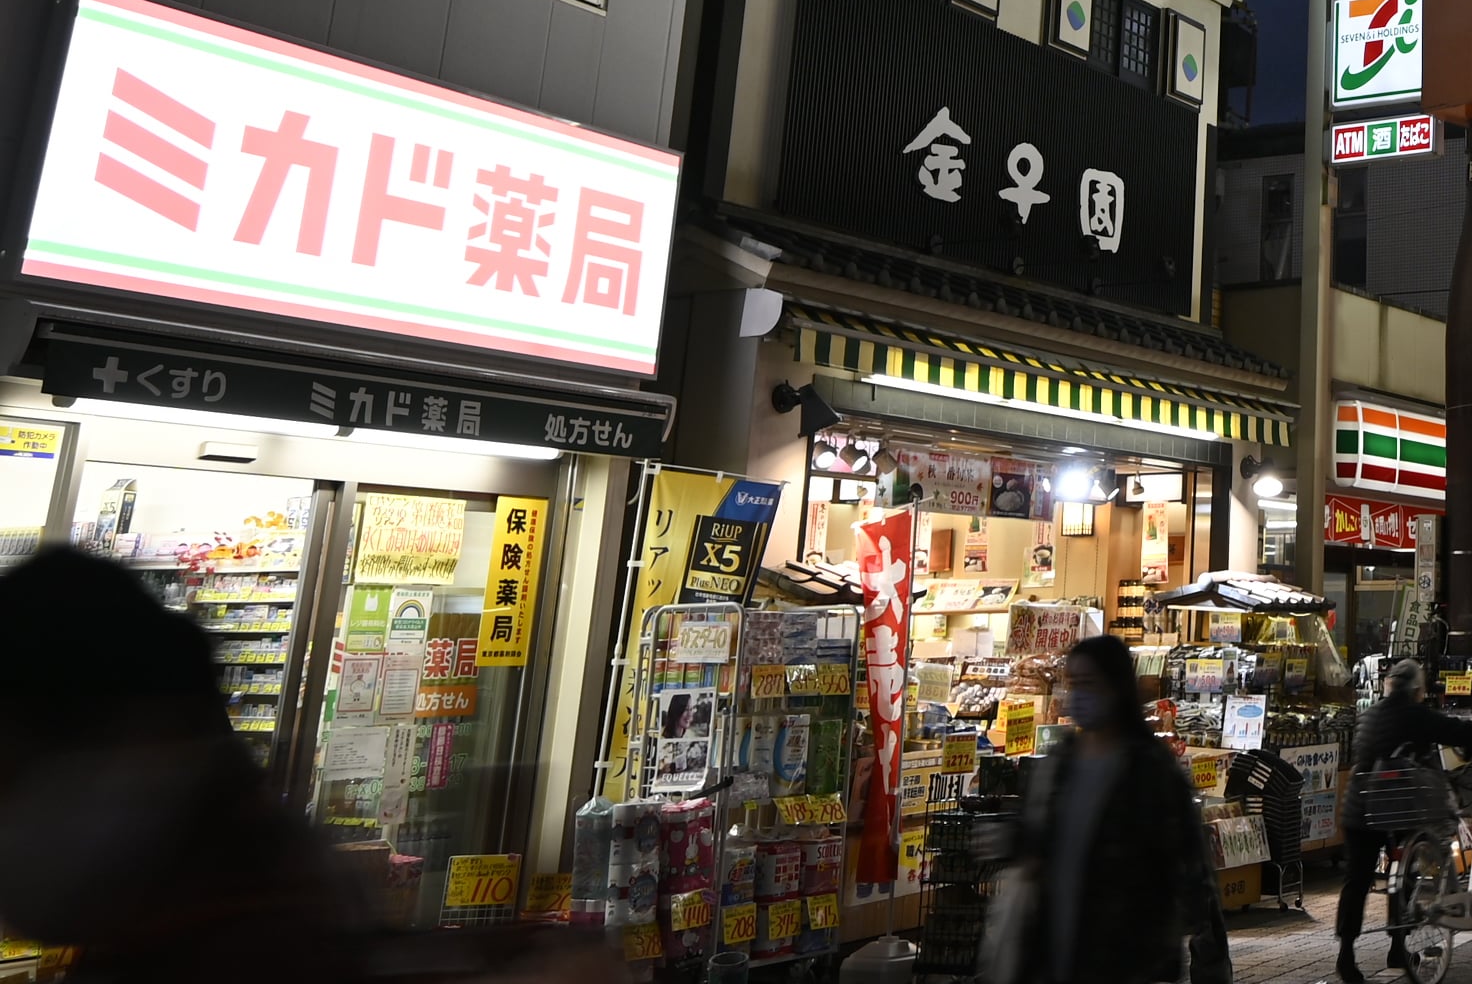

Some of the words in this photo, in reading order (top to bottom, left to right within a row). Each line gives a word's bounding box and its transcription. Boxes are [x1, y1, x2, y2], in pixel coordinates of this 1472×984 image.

[1377, 23, 1420, 39] HOLDINGS
[1335, 127, 1364, 156] ATM
[1372, 126, 1392, 151] 酒
[1400, 116, 1430, 147] たばこ
[94, 67, 645, 316] ミカド薬局
[137, 363, 227, 404] くすり
[309, 380, 481, 436] ミカド薬局
[543, 413, 634, 450] 処方せん
[711, 522, 743, 540] RiUP
[699, 542, 743, 573] X5
[490, 507, 528, 644] 保険薬局
[690, 577, 710, 587] Plus
[710, 575, 741, 593] NEO
[422, 637, 480, 680] 薬局
[416, 692, 468, 712] 処方せん
[470, 876, 514, 903] 110
